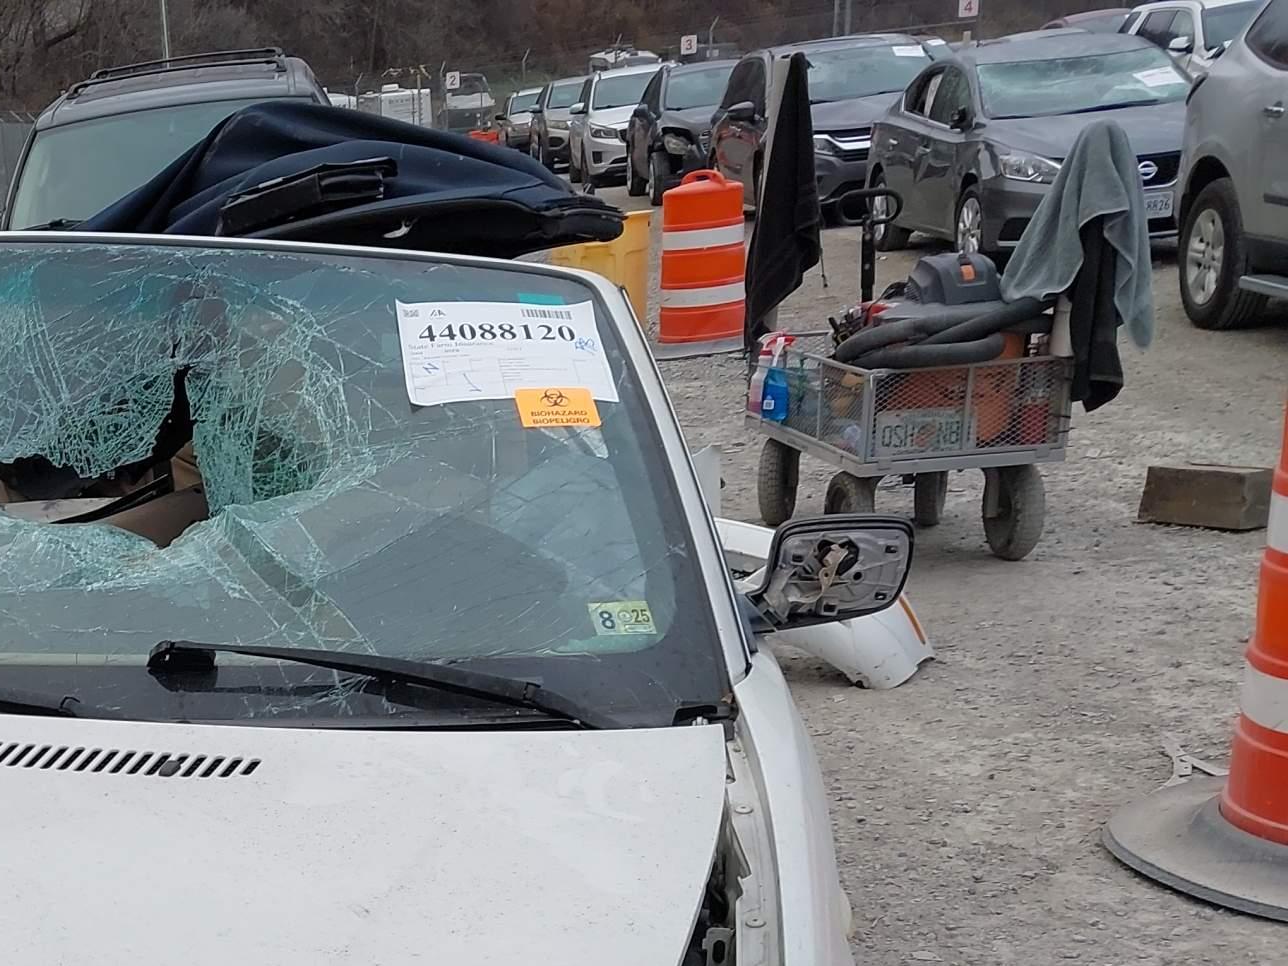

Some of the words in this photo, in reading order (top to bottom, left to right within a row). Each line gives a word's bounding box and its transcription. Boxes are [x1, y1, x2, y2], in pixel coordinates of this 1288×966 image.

[965, 0, 974, 12] 4
[684, 39, 694, 51] 3
[449, 75, 457, 86] 2
[419, 323, 575, 342] 44088120
[530, 410, 587, 418] BIOHAZARD
[532, 417, 591, 425] BIOPELIGRO
[598, 610, 616, 630] 8
[631, 609, 650, 623] 25
